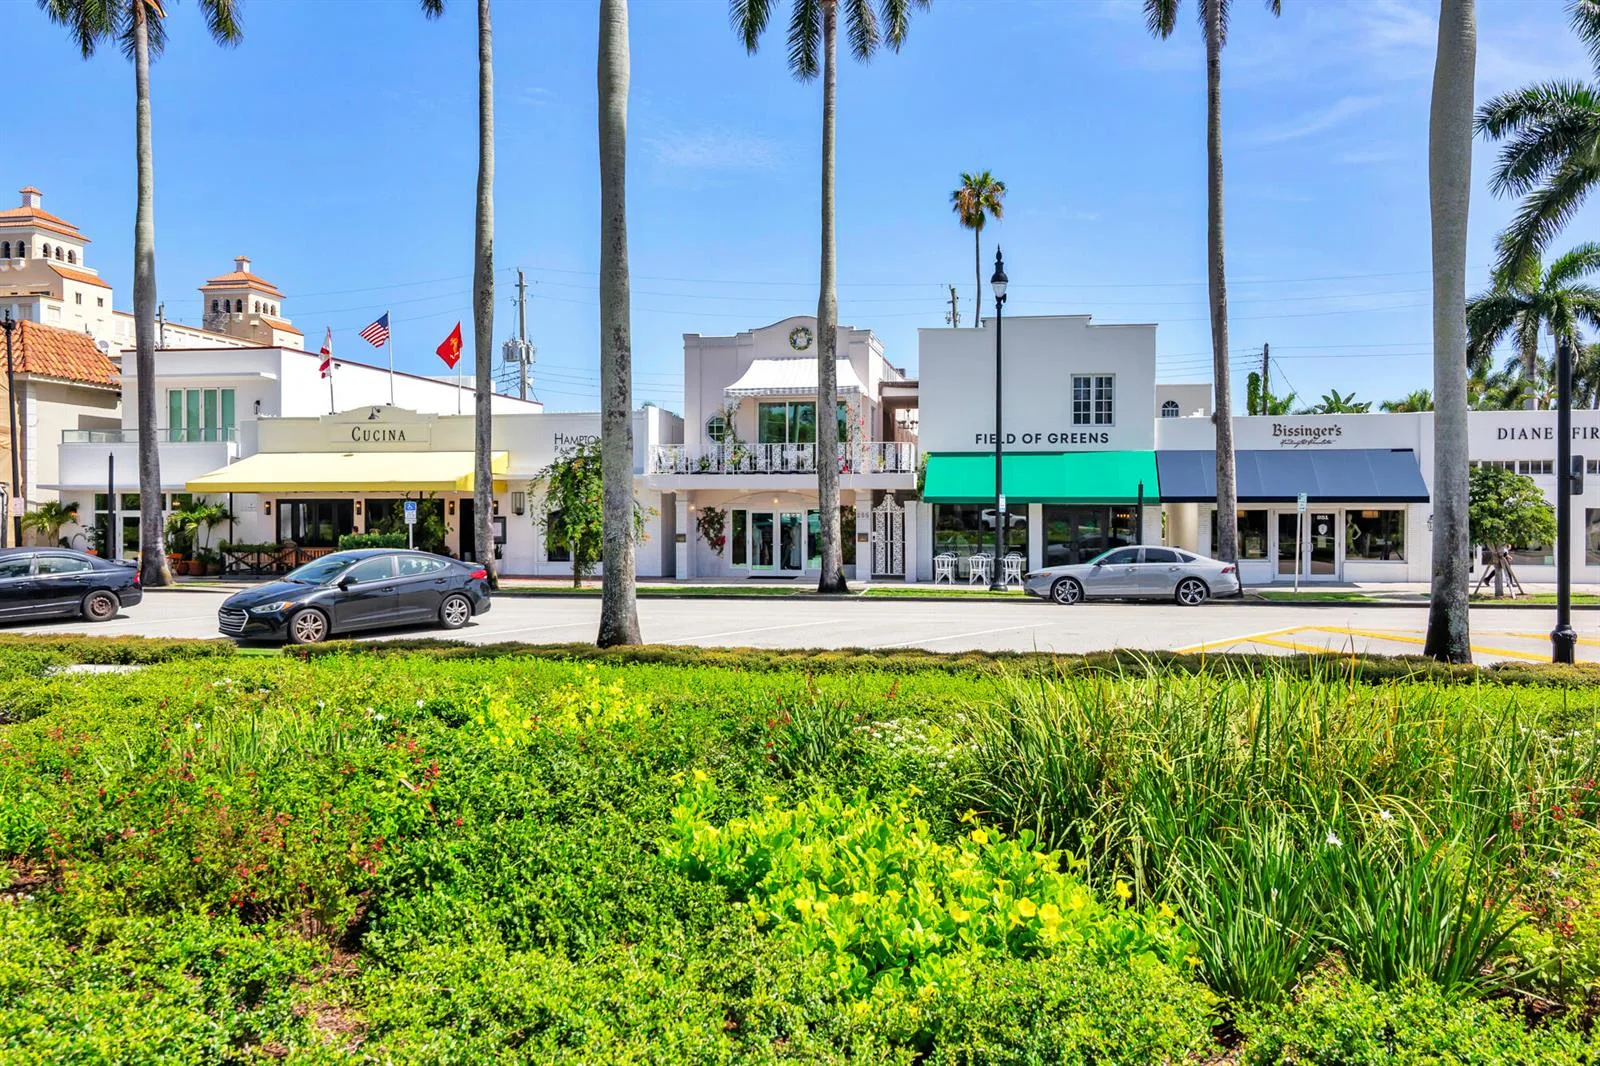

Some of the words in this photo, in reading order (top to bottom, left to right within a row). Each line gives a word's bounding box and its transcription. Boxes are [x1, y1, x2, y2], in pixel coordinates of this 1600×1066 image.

[351, 426, 406, 441] CUCINA
[1022, 433, 1042, 444] OF
[1047, 432, 1109, 444] GREENS
[1272, 423, 1342, 440] Bissinger's
[1497, 427, 1554, 440] DIANE
[1572, 427, 1600, 440] FIR
